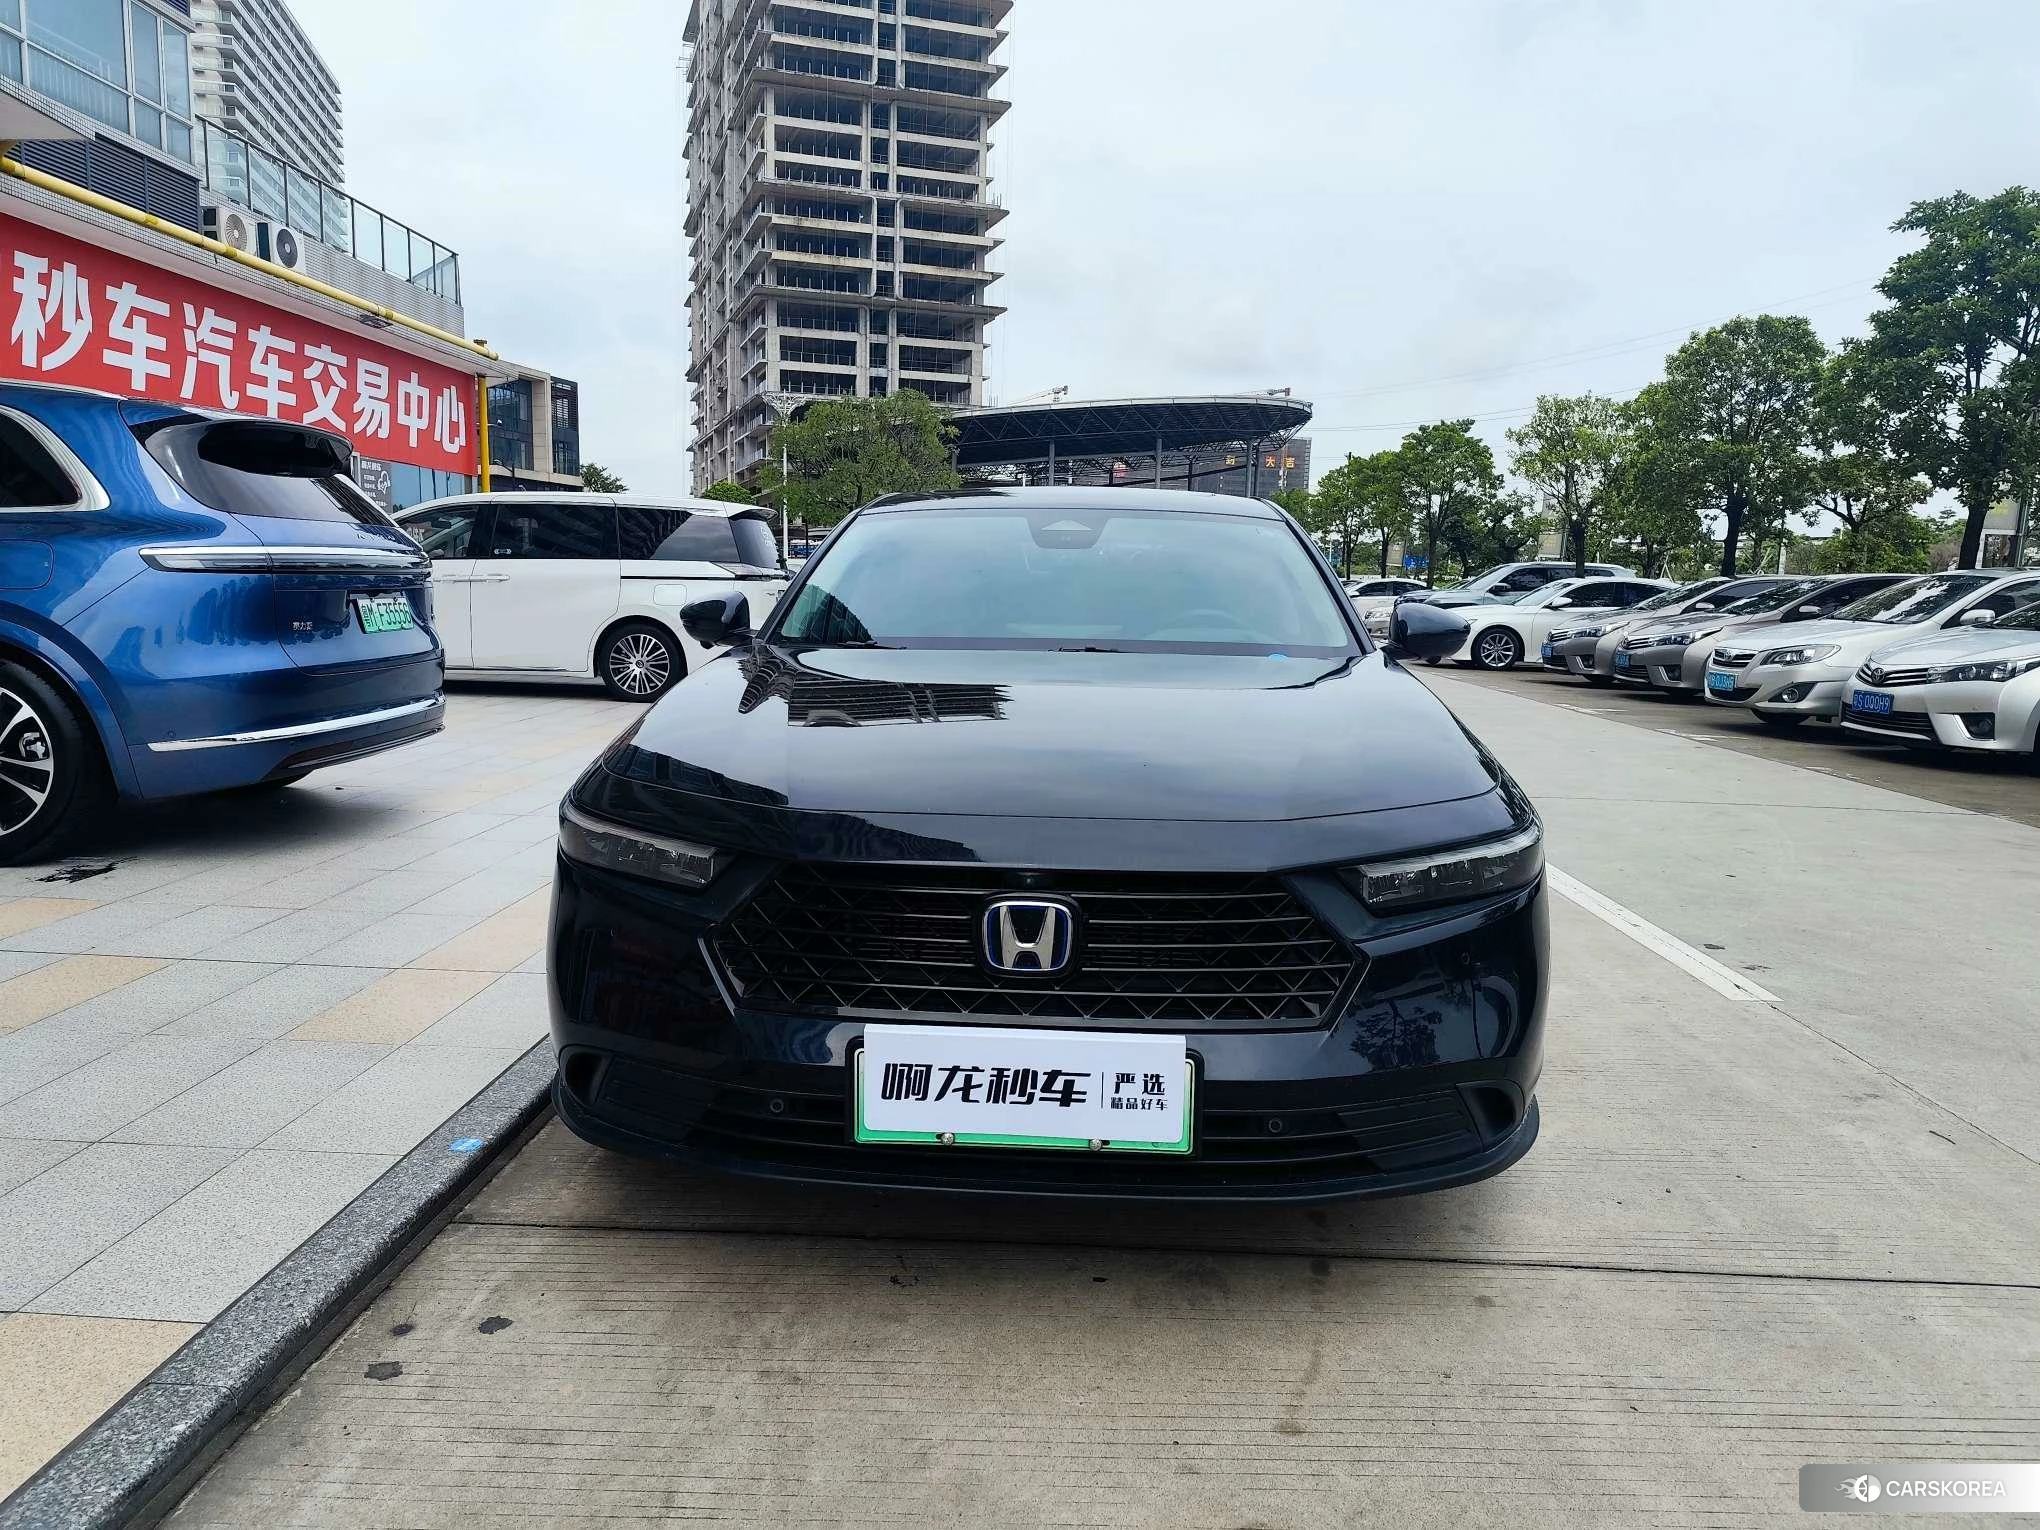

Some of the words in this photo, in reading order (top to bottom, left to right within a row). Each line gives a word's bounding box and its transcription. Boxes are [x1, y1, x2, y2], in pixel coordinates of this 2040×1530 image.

[10, 250, 466, 454] 秒车汽车交易中心
[881, 1062, 1092, 1108] 啊龙秒车
[1113, 1071, 1166, 1096] 严选
[1110, 1096, 1169, 1111] 精品好车
